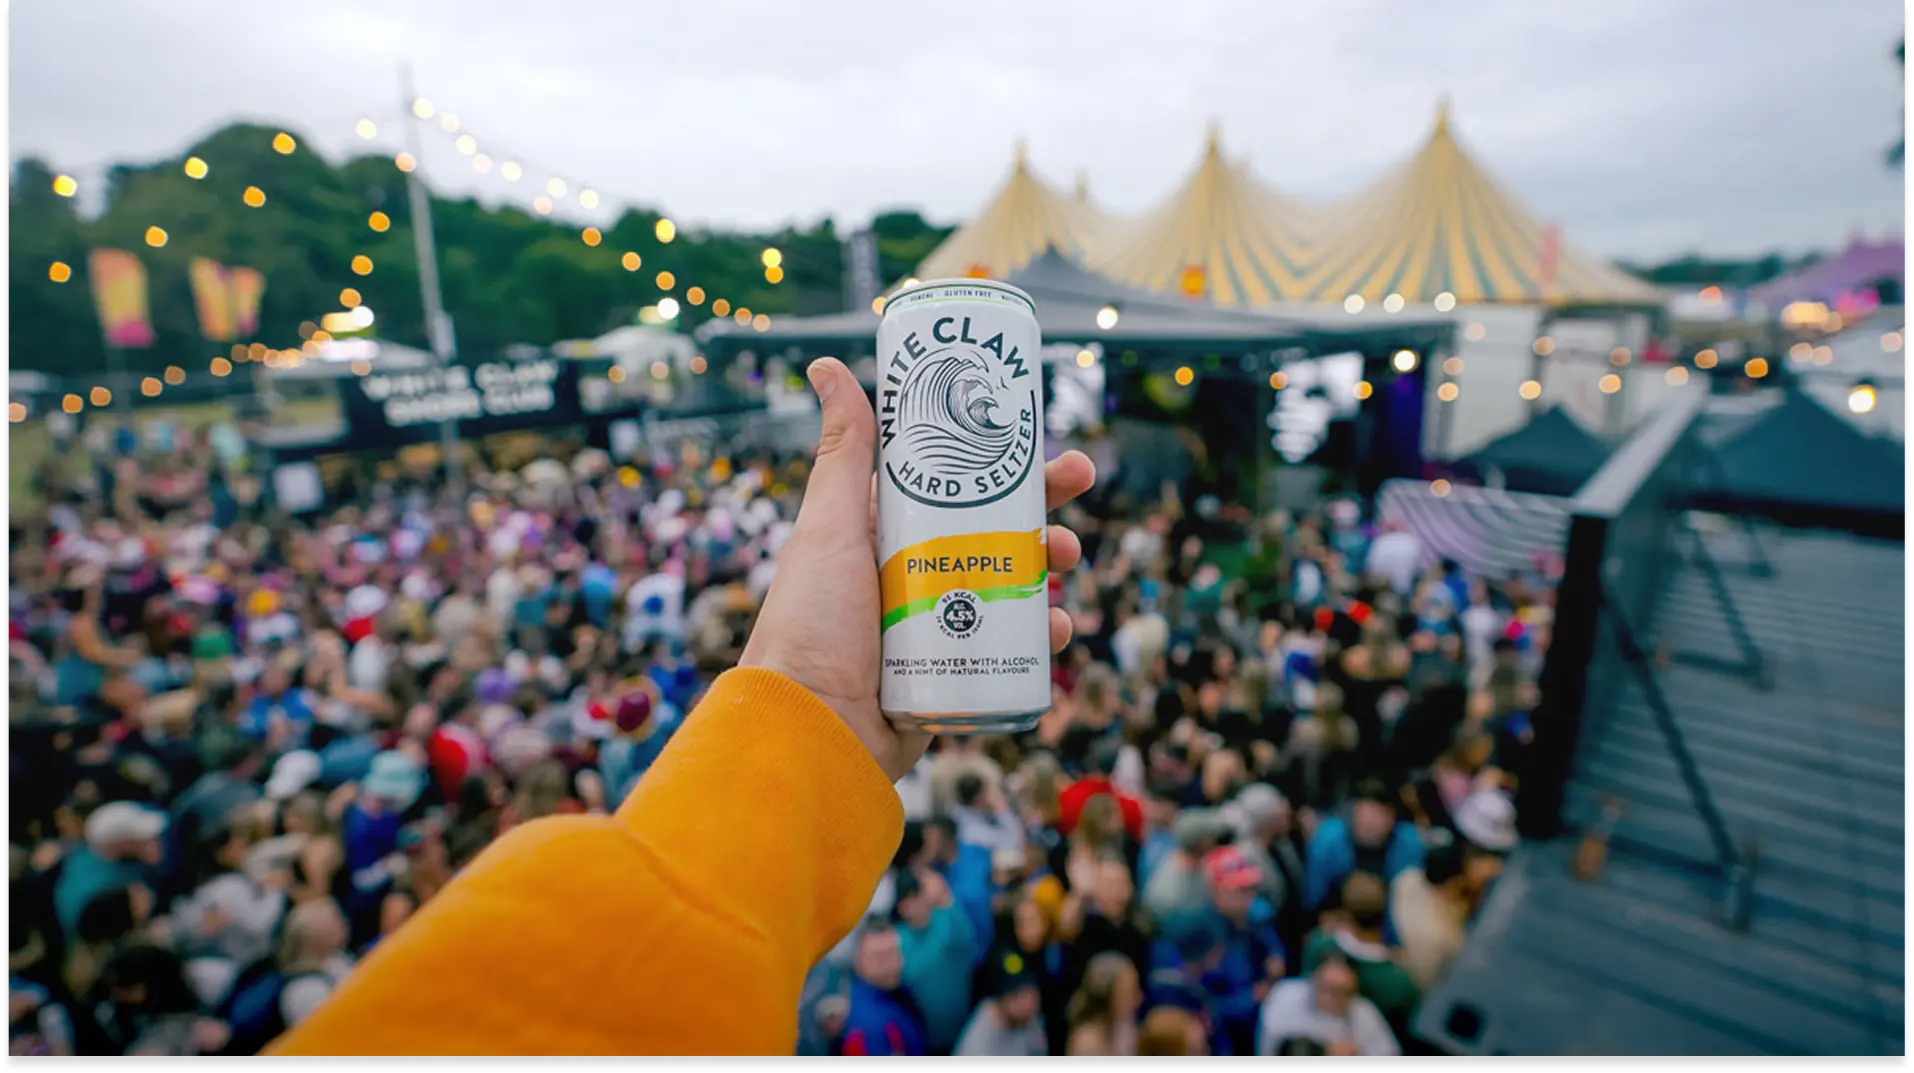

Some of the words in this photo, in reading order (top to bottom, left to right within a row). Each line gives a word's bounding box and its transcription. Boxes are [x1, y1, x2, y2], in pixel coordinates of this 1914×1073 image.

[881, 331, 927, 449] WHITE
[932, 316, 1030, 380] CLAW
[899, 461, 961, 497] HARD
[974, 408, 1031, 493] SELTZER
[907, 556, 1013, 574] PINEAPPLE
[885, 659, 928, 667] SPARKLING
[931, 658, 967, 667] WATER
[970, 658, 999, 667] WITH
[1002, 657, 1040, 667] ALCOHOL
[950, 668, 990, 676] NATURAL
[992, 667, 1030, 675] FLAVOURS
